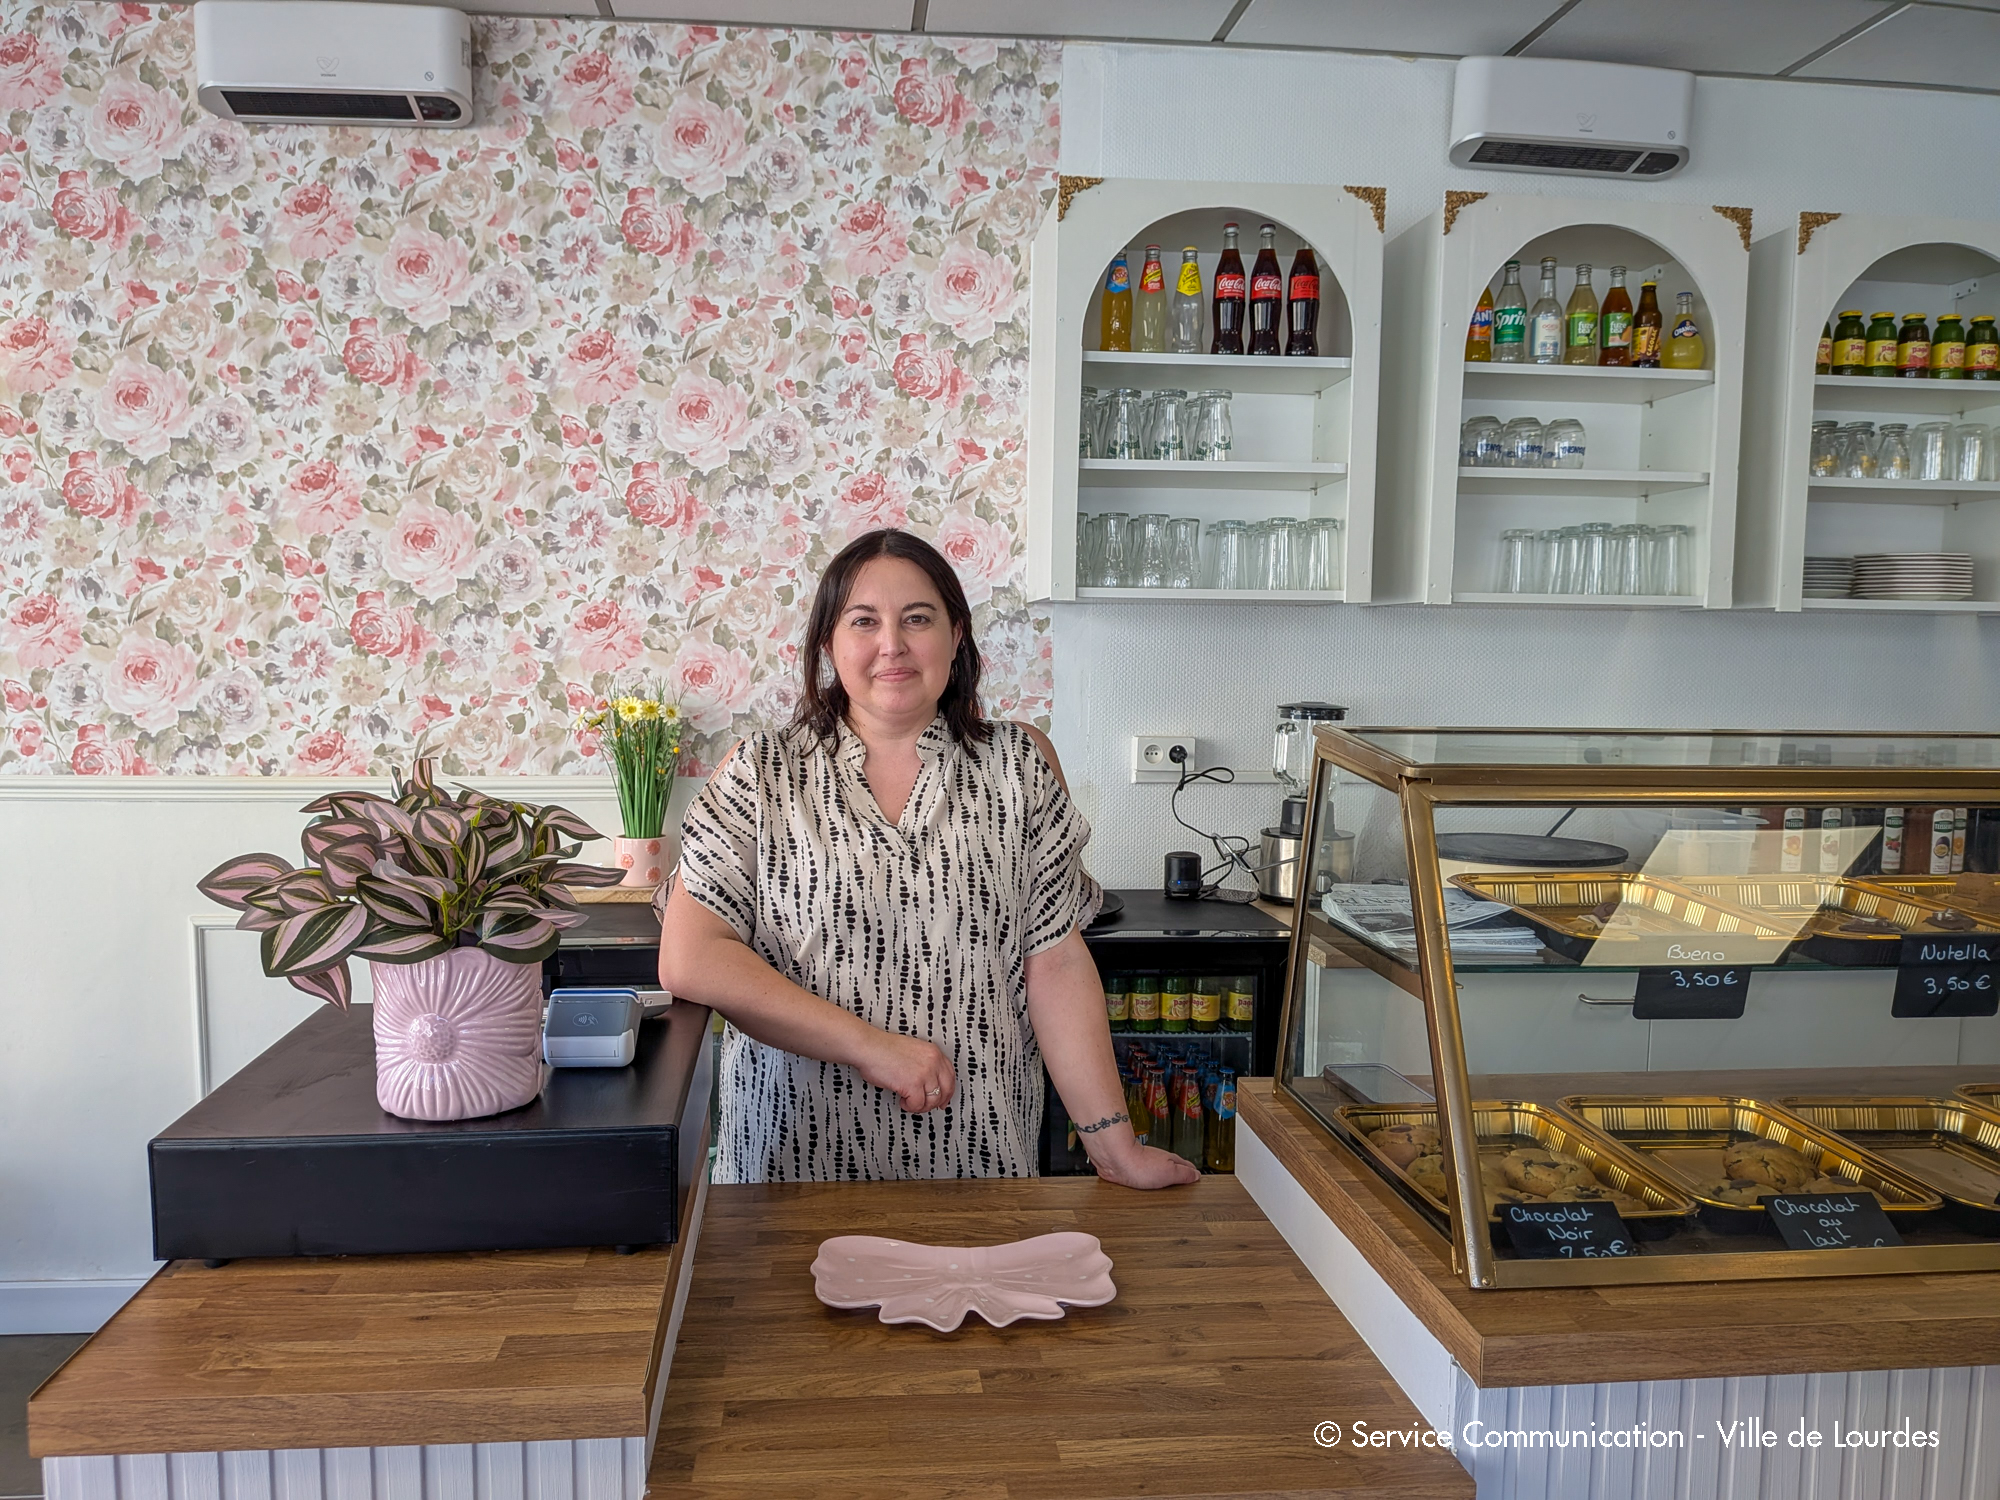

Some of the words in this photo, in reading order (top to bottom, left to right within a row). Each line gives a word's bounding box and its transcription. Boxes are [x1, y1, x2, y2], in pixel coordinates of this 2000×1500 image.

[1473, 310, 1492, 322] ANT
[1667, 944, 1725, 961] Bueno
[1920, 943, 1991, 961] Nutella
[1510, 1206, 1594, 1222] Chocolat
[1774, 1197, 1860, 1216] Chocolat
[1819, 1218, 1843, 1227] au
[1547, 1224, 1593, 1241] Noir
